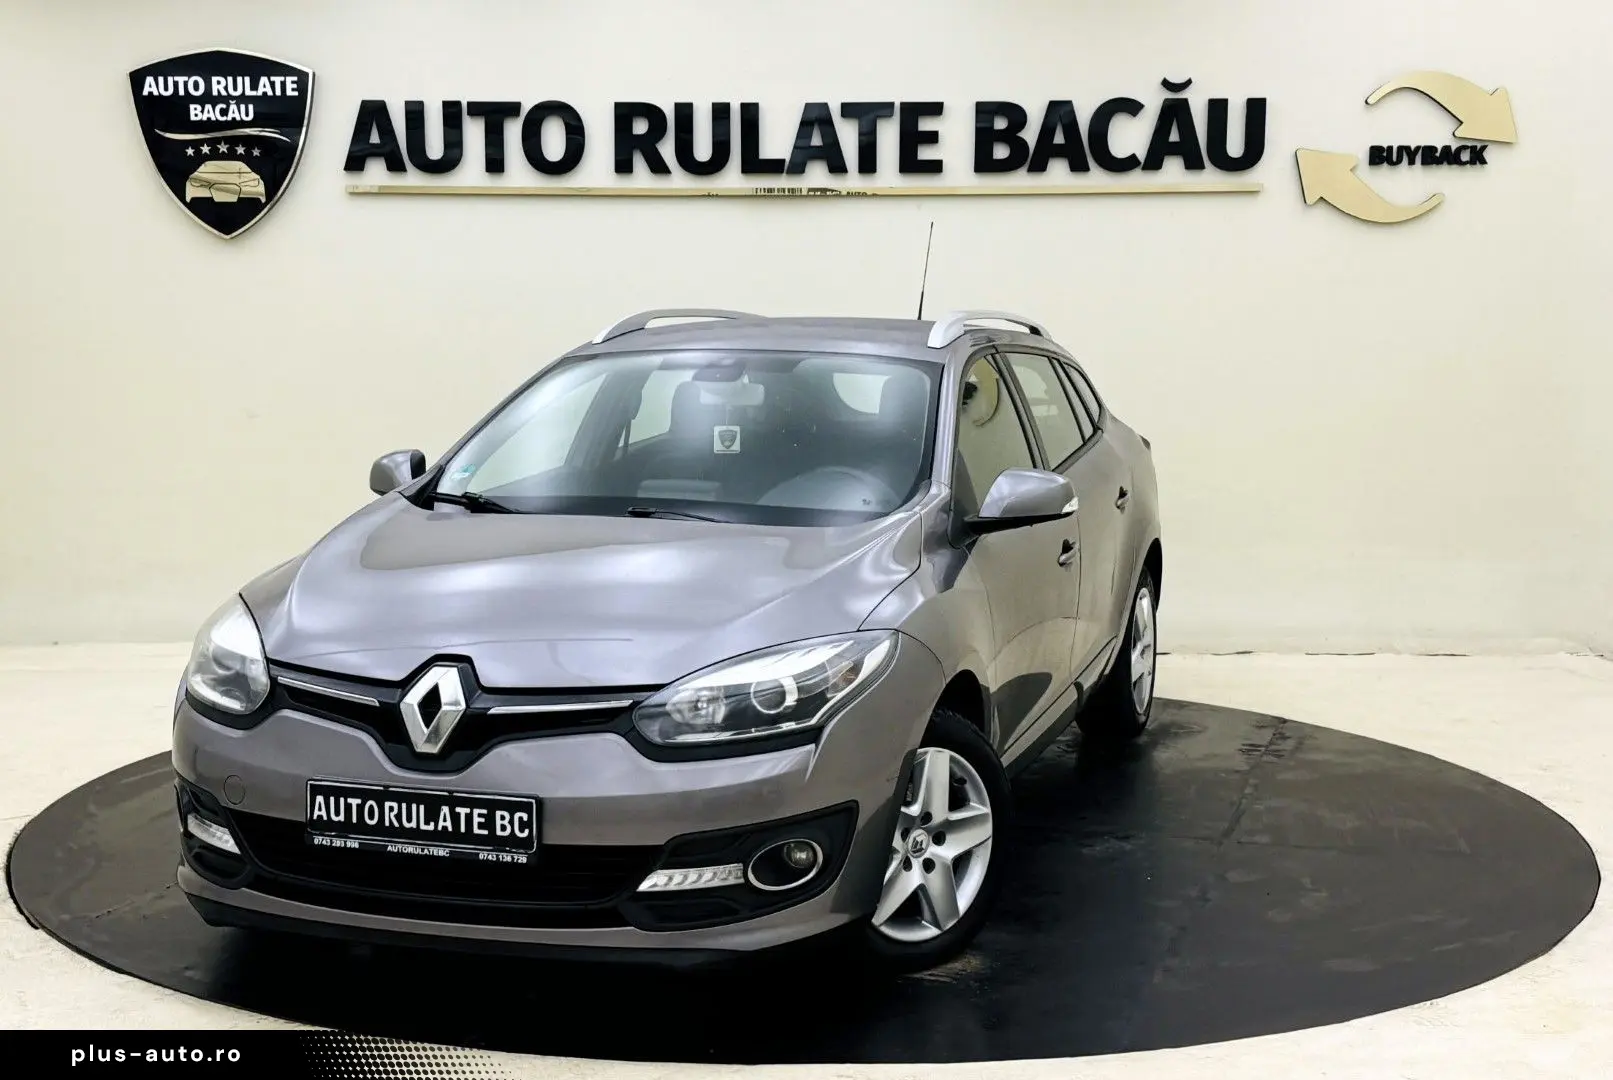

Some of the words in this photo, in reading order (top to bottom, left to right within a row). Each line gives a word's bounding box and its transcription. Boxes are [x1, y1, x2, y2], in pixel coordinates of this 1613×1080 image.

[142, 76, 205, 97] AUTO
[211, 76, 299, 97] RULATE
[189, 101, 254, 121] BACĂU
[344, 99, 586, 175] AUTO
[613, 100, 944, 175] RULATE
[973, 77, 1267, 174] BACĂU
[1368, 145, 1489, 166] BUYBACK
[313, 795, 379, 825] AUTO
[384, 801, 489, 836] RULATE
[495, 810, 530, 838] BC
[387, 844, 450, 857] AUTORULATEBC
